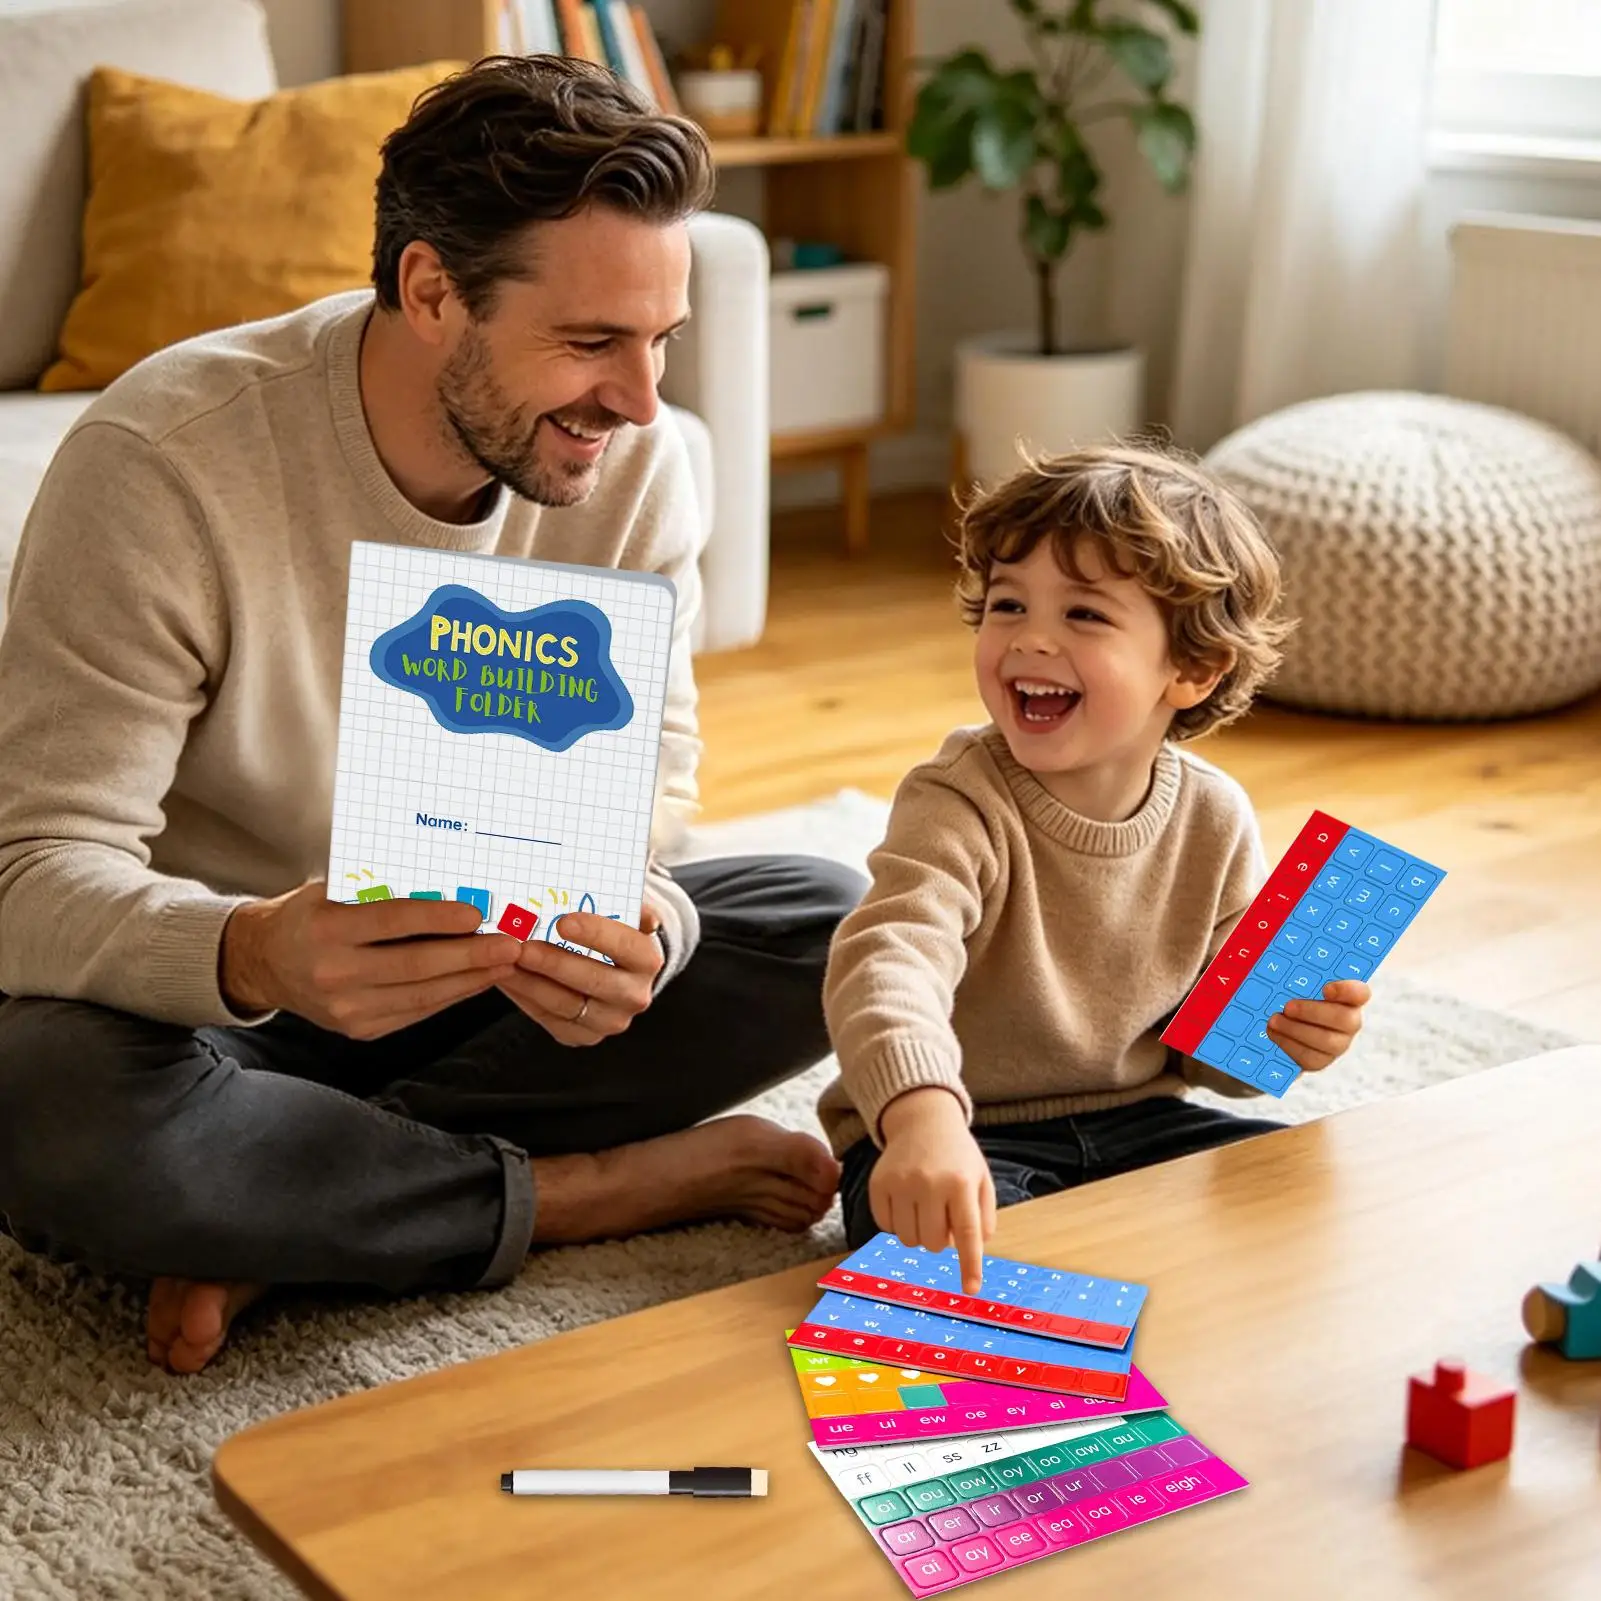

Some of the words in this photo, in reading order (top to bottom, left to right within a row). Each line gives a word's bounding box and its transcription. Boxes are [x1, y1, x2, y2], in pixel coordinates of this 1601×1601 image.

[430, 614, 579, 668] PHONICS
[402, 653, 467, 682] WORD
[480, 664, 598, 703] BUILDING
[454, 686, 541, 724] FOLDER
[415, 813, 468, 831] Name:
[1316, 832, 1329, 843] a
[1297, 862, 1308, 872] e
[512, 917, 522, 928] e
[1257, 920, 1269, 930] o
[829, 1424, 854, 1434] ue
[879, 1418, 897, 1429] ui
[919, 1415, 946, 1425] ew
[965, 1410, 987, 1420] oe
[1006, 1406, 1026, 1416] ey
[856, 1473, 872, 1486] ff
[942, 1452, 963, 1464] ss
[981, 1442, 1002, 1454] zz
[876, 1498, 897, 1514] oi
[1002, 1464, 1025, 1480] oy
[1039, 1455, 1062, 1467] oo
[1075, 1442, 1100, 1457] aw
[1112, 1431, 1136, 1446] au
[896, 1529, 917, 1544] ar
[942, 1516, 963, 1530] er
[1026, 1491, 1046, 1504] or
[1064, 1479, 1083, 1492] ur
[920, 1559, 943, 1575] ai
[964, 1545, 990, 1562] ay
[1009, 1531, 1034, 1546] ee
[1050, 1518, 1075, 1532] ea
[1088, 1504, 1113, 1519] oa
[1164, 1473, 1203, 1495] eigh
